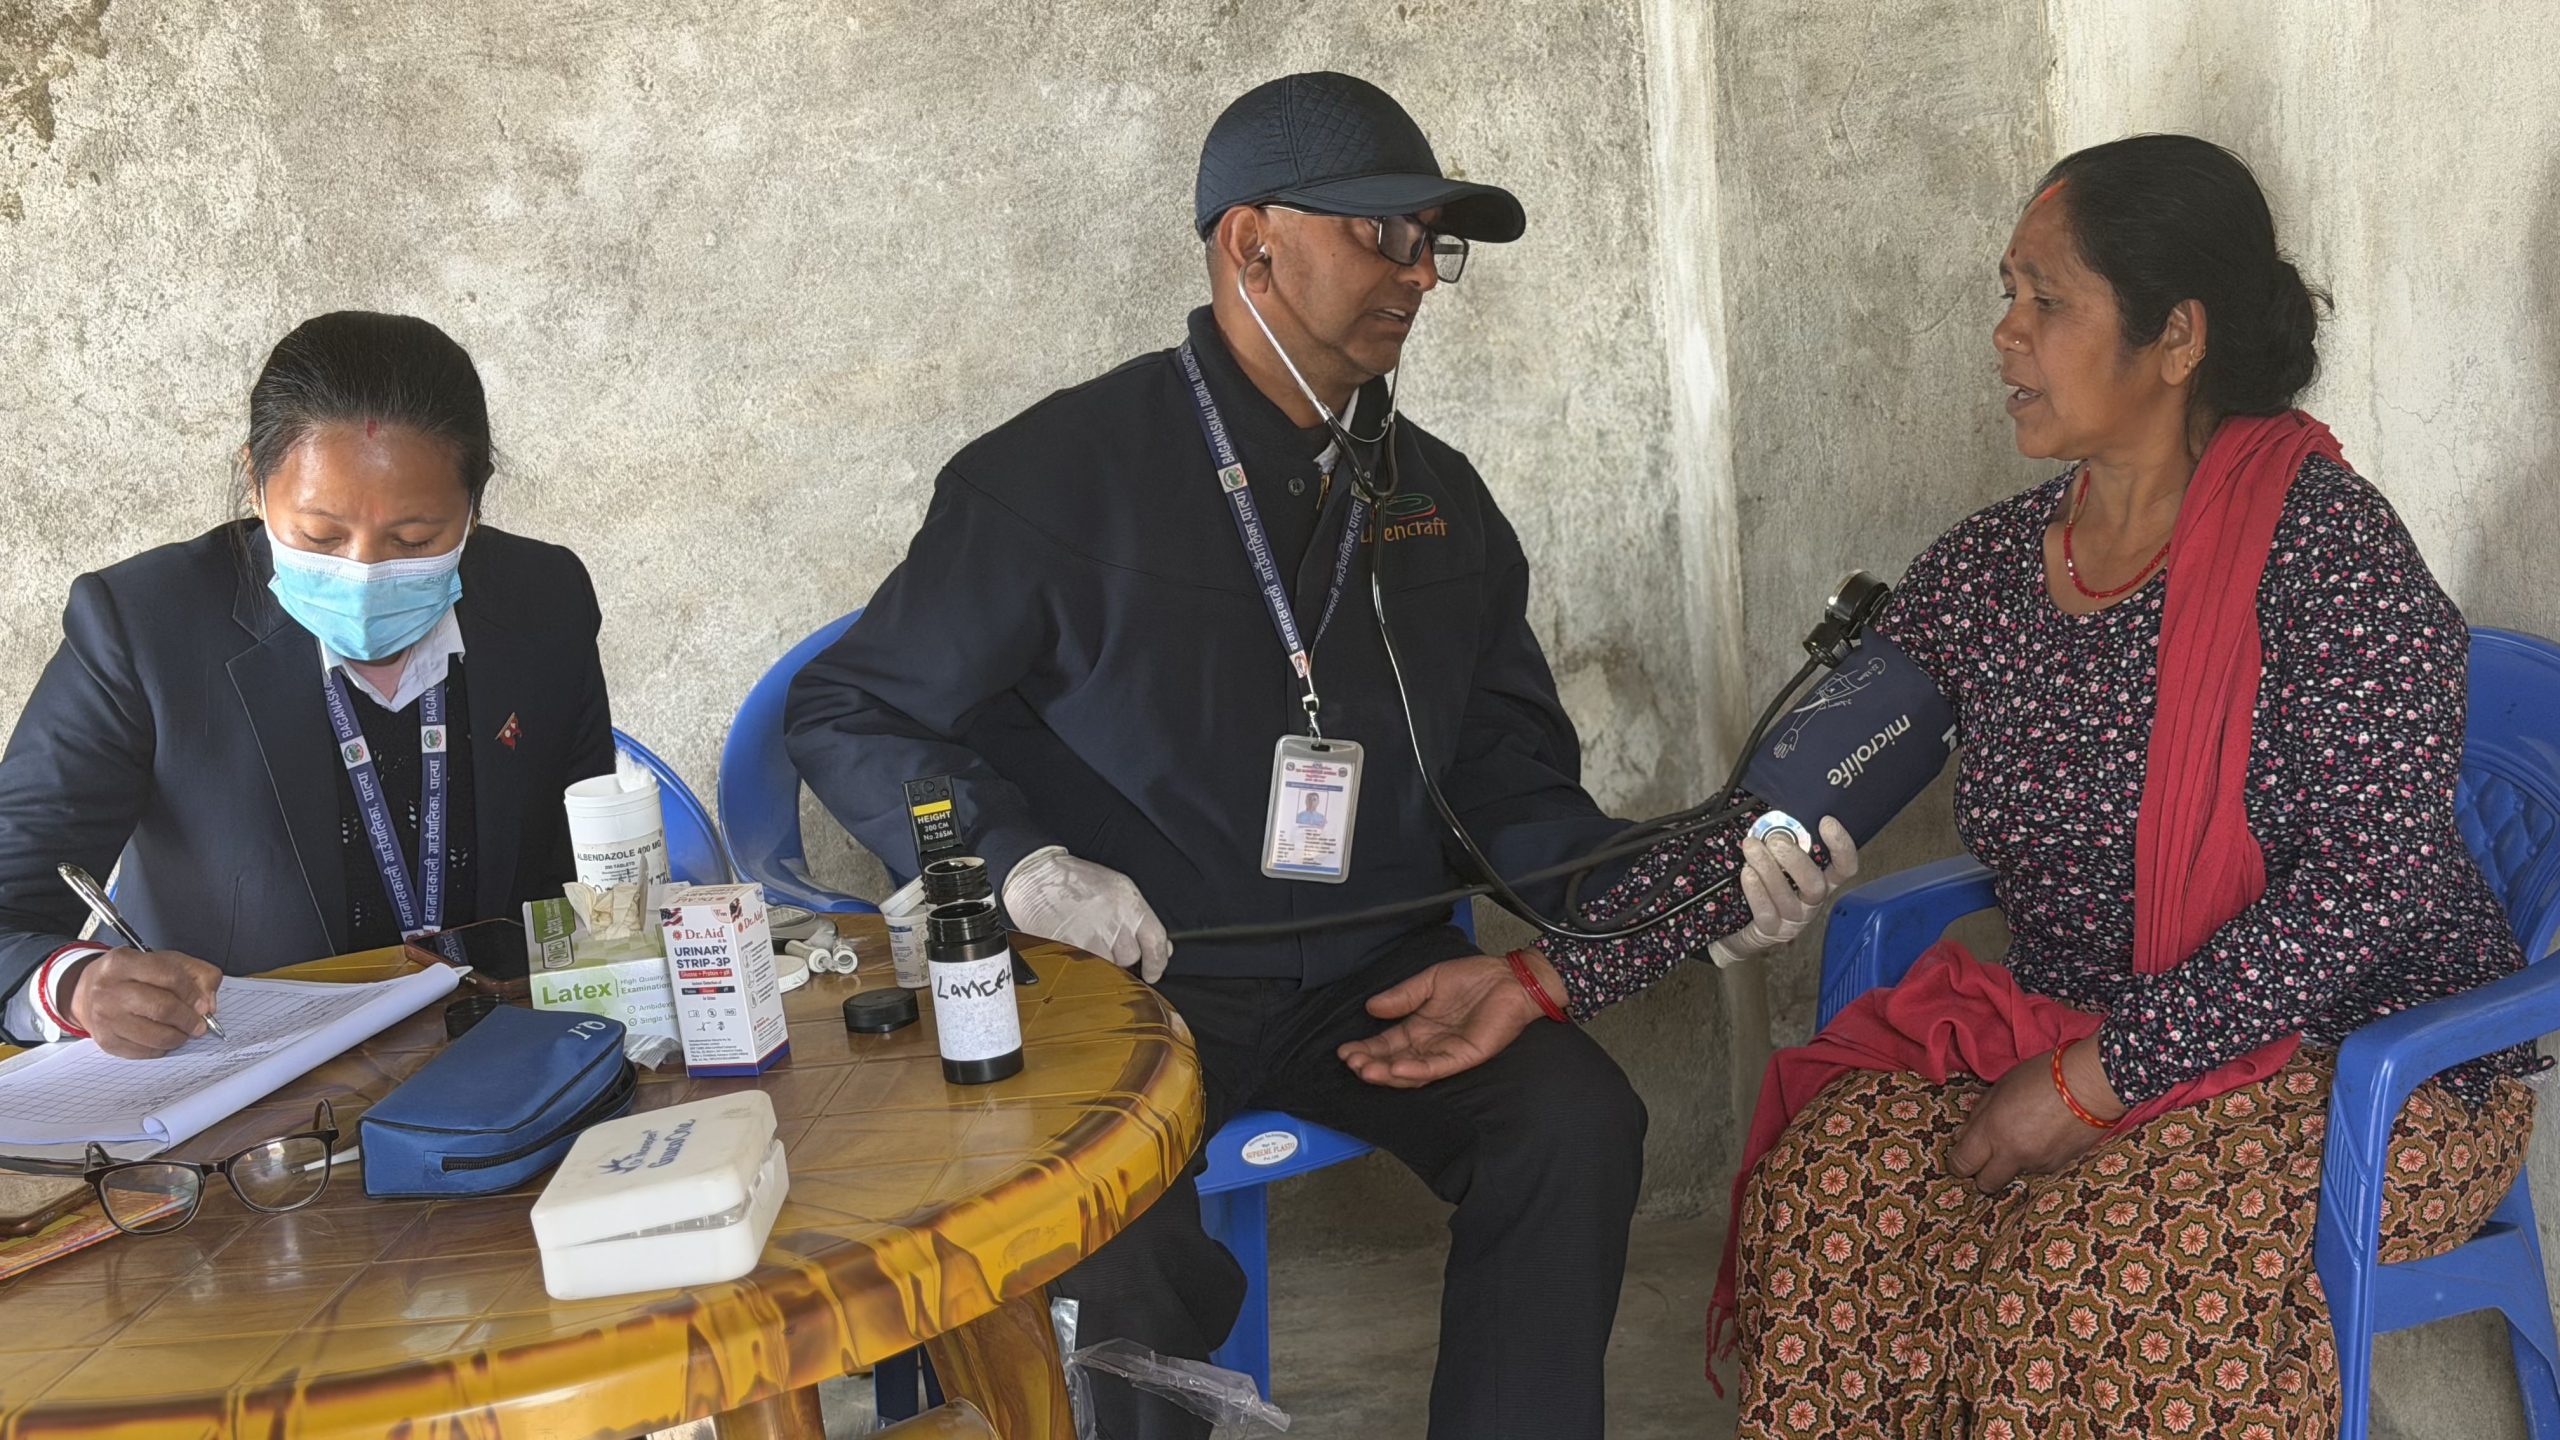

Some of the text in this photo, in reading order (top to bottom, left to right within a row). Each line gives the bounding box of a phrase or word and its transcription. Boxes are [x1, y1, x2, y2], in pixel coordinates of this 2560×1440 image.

[1193, 379, 1214, 407] RURAL
[1360, 517, 1448, 543] Liencraft
[426, 685, 438, 723] BAGAN
[1827, 714, 1911, 789] microlife
[917, 810, 952, 824] HEIGHT
[938, 821, 949, 829] CM
[674, 944, 728, 957] URINARY
[676, 957, 731, 969] STRIP-3P
[542, 981, 612, 1005] Latex
